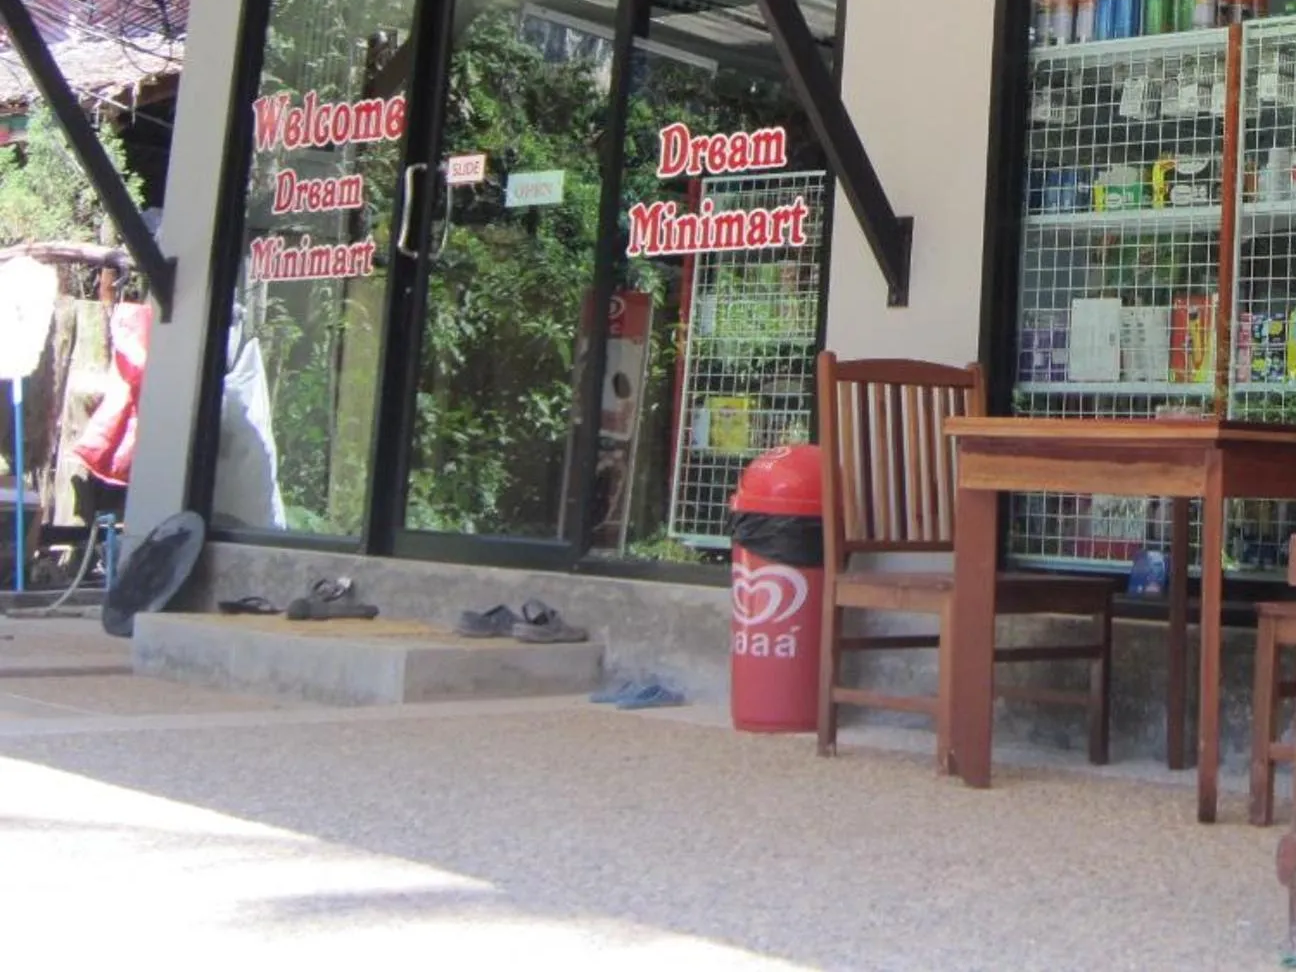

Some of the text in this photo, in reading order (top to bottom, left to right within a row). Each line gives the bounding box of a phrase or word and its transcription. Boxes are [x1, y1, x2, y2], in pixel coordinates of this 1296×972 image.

[253, 90, 407, 152] Welcome
[452, 160, 480, 177] SLIDE
[657, 122, 786, 178] Dream
[272, 168, 363, 214] Dream
[627, 196, 808, 258] Minimart
[250, 234, 376, 282] Minimart
